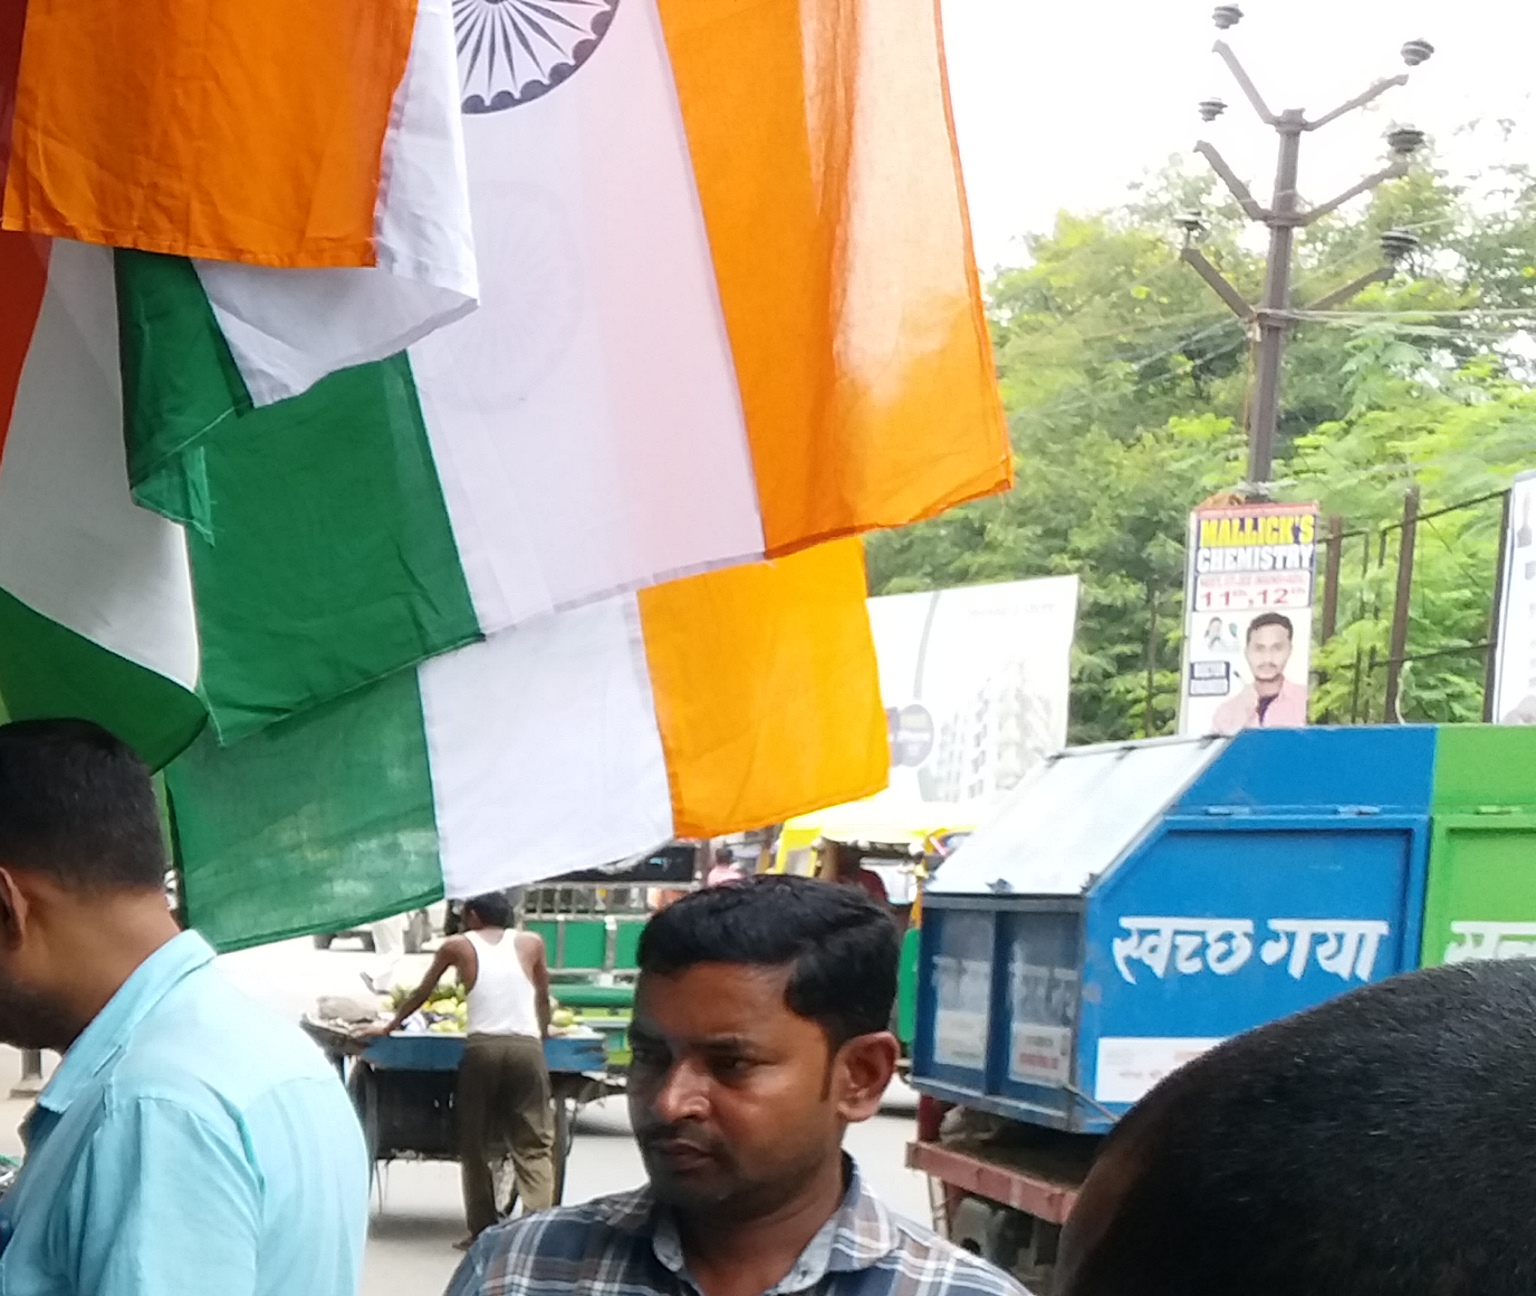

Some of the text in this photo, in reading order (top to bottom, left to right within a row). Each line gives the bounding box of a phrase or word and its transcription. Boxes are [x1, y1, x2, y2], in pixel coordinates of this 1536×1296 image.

[1199, 514, 1315, 548] MALLICK'S
[1197, 544, 1314, 573] CHEMISTRY
[1260, 917, 1389, 982] गया
